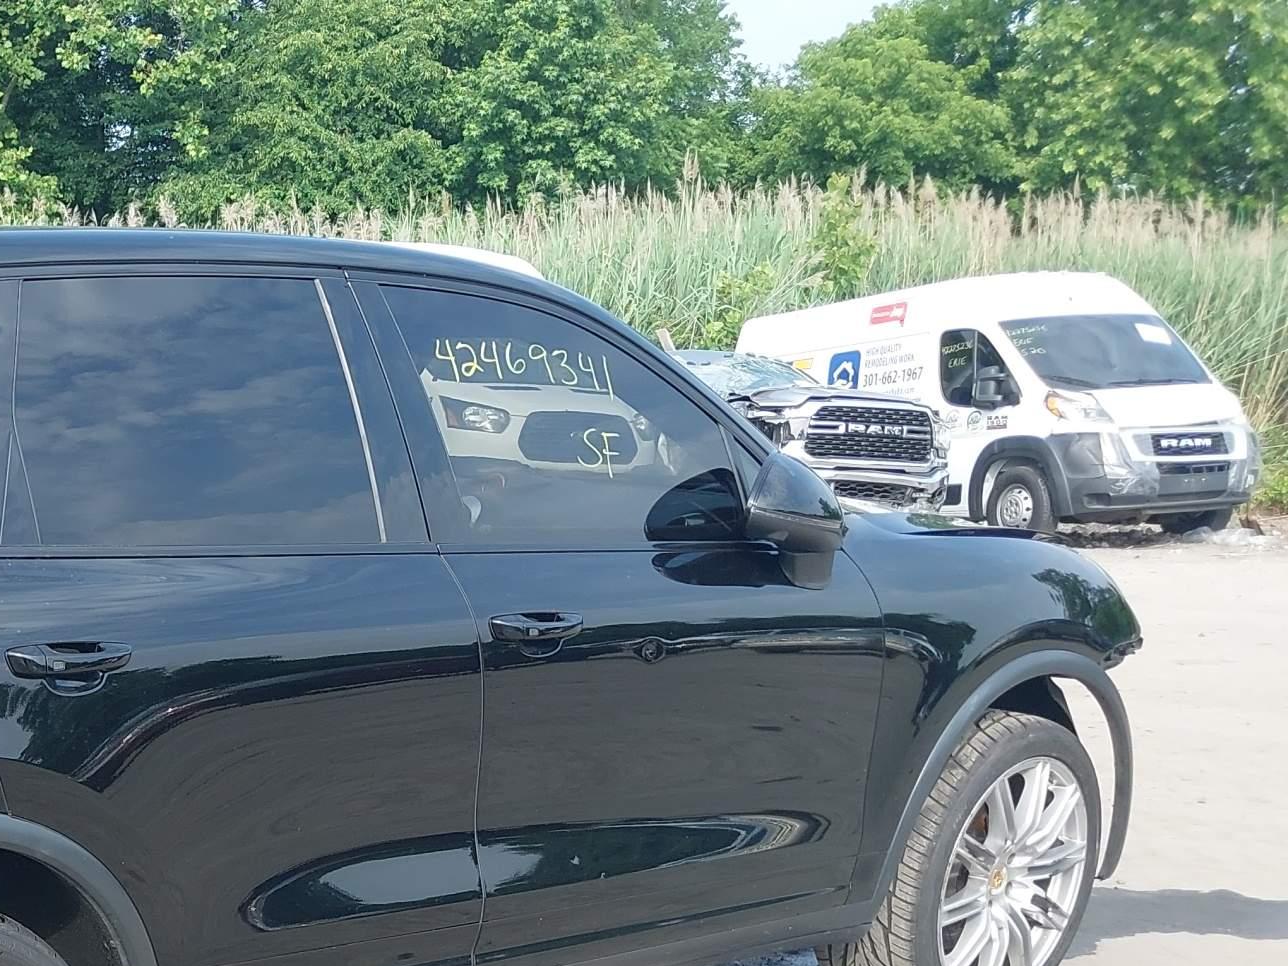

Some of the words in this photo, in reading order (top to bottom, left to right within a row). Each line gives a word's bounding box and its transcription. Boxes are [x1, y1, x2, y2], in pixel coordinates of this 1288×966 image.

[435, 338, 614, 401] 42469341
[863, 366, 924, 388] 301-662-1967
[577, 428, 620, 479] SF
[1160, 438, 1212, 448] RAM
